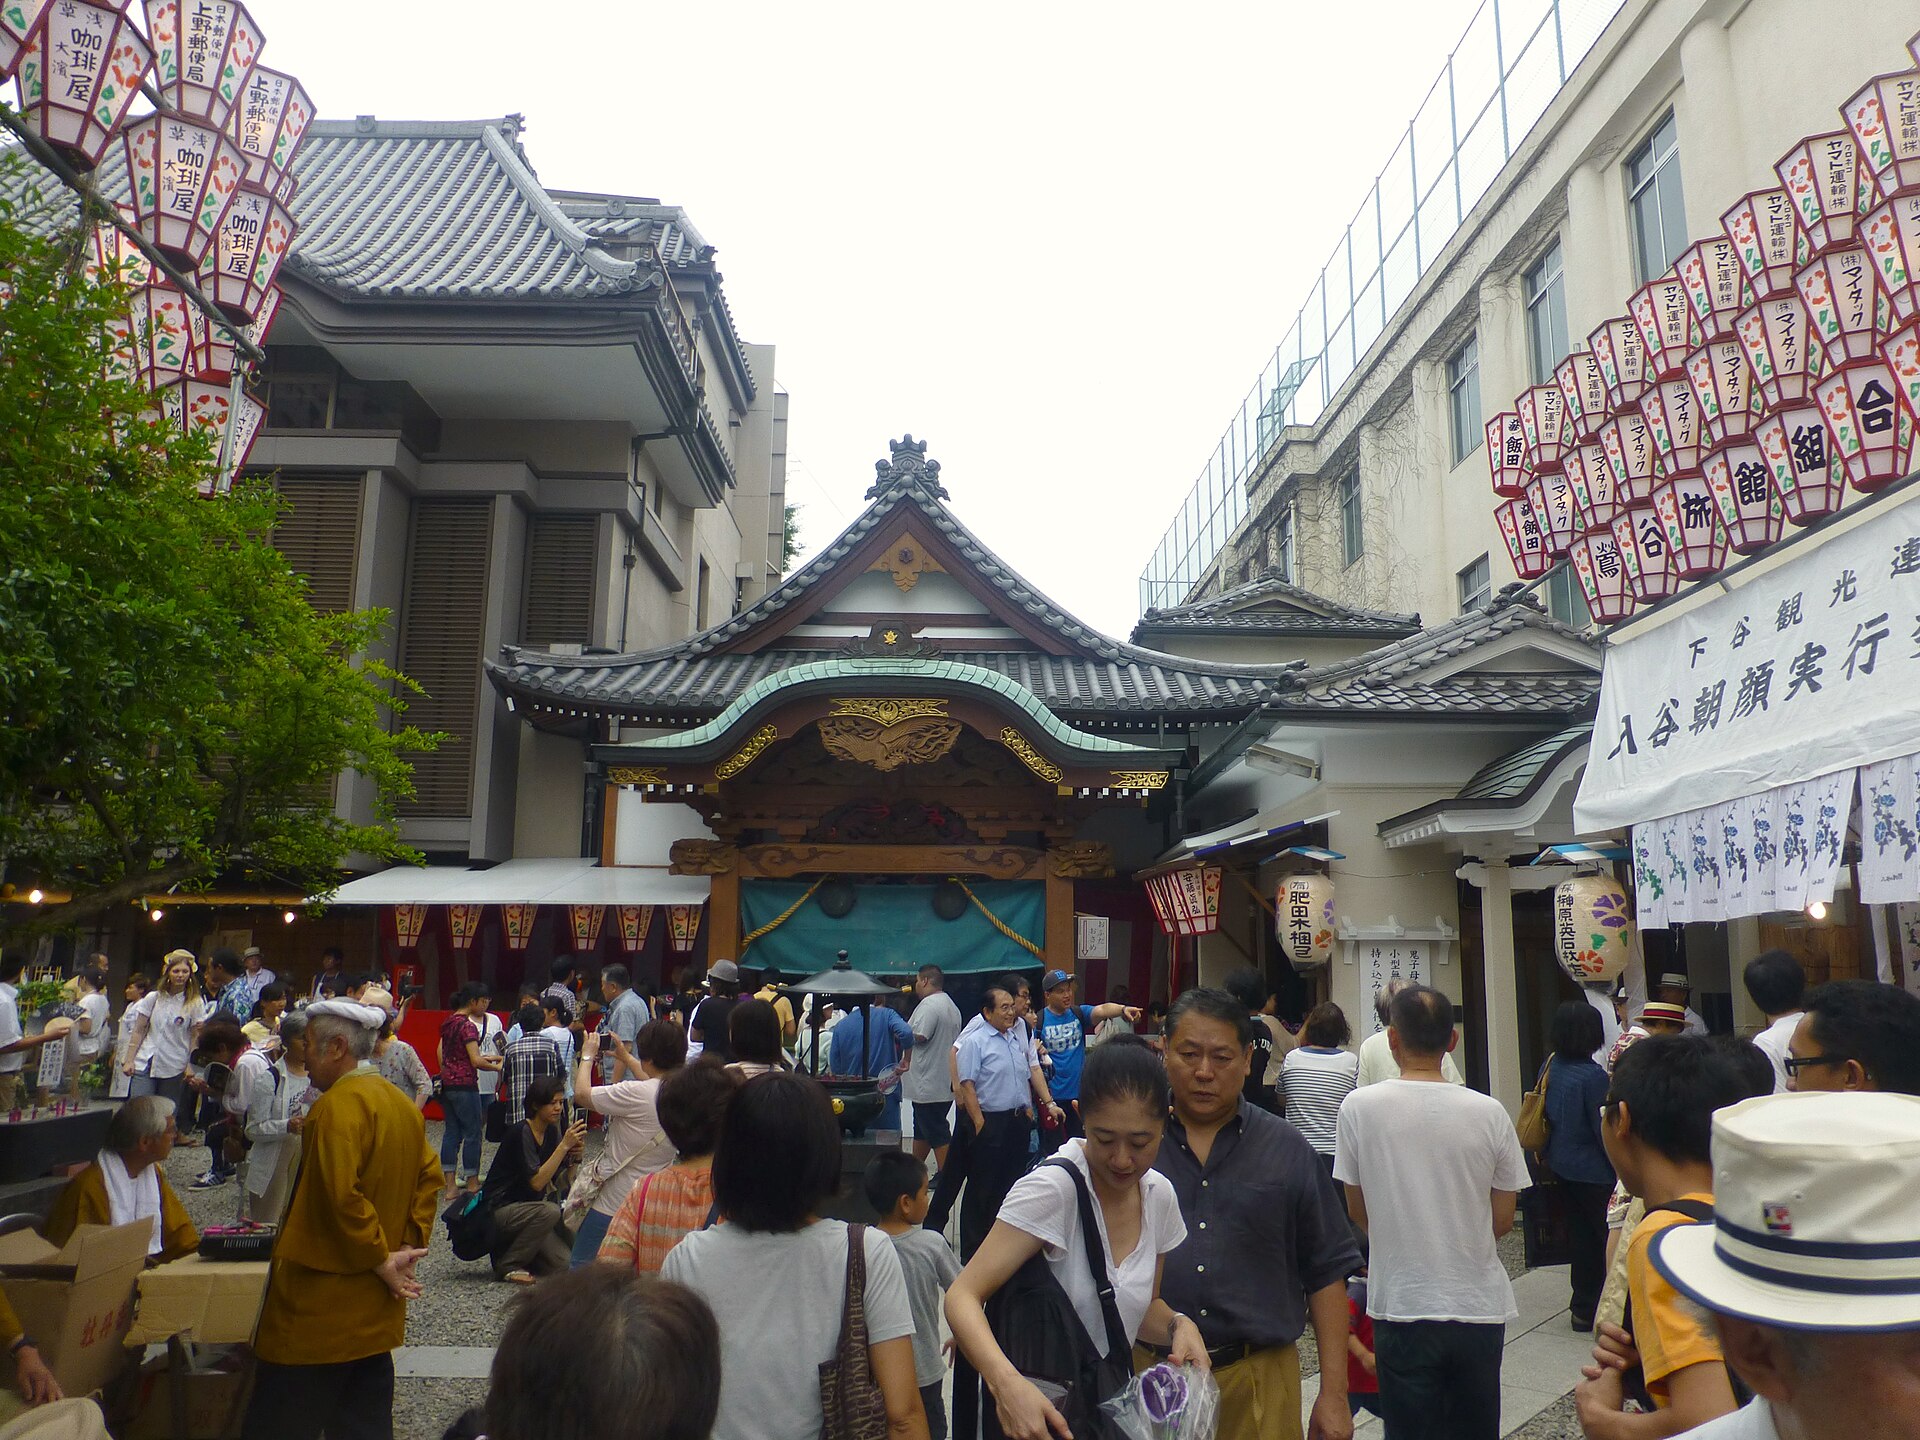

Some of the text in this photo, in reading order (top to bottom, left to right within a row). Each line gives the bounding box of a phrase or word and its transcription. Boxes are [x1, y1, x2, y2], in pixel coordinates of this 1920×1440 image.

[187, 1, 213, 82] 上野郵便局
[243, 75, 269, 152] 上野郵便局
[1841, 255, 1863, 326] (株)マイタック
[1775, 302, 1799, 370] (株)マイタック
[1721, 345, 1741, 408] (株)マイタック
[1629, 417, 1645, 473] (株)マイタック
[1673, 384, 1690, 443] (株)マイタック
[1551, 476, 1567, 528] (株)マイタック
[1639, 517, 1665, 558] 谷
[1682, 493, 1711, 529] 旅
[1735, 462, 1767, 505] 館
[1791, 425, 1825, 472] 組
[1856, 379, 1893, 434] 合
